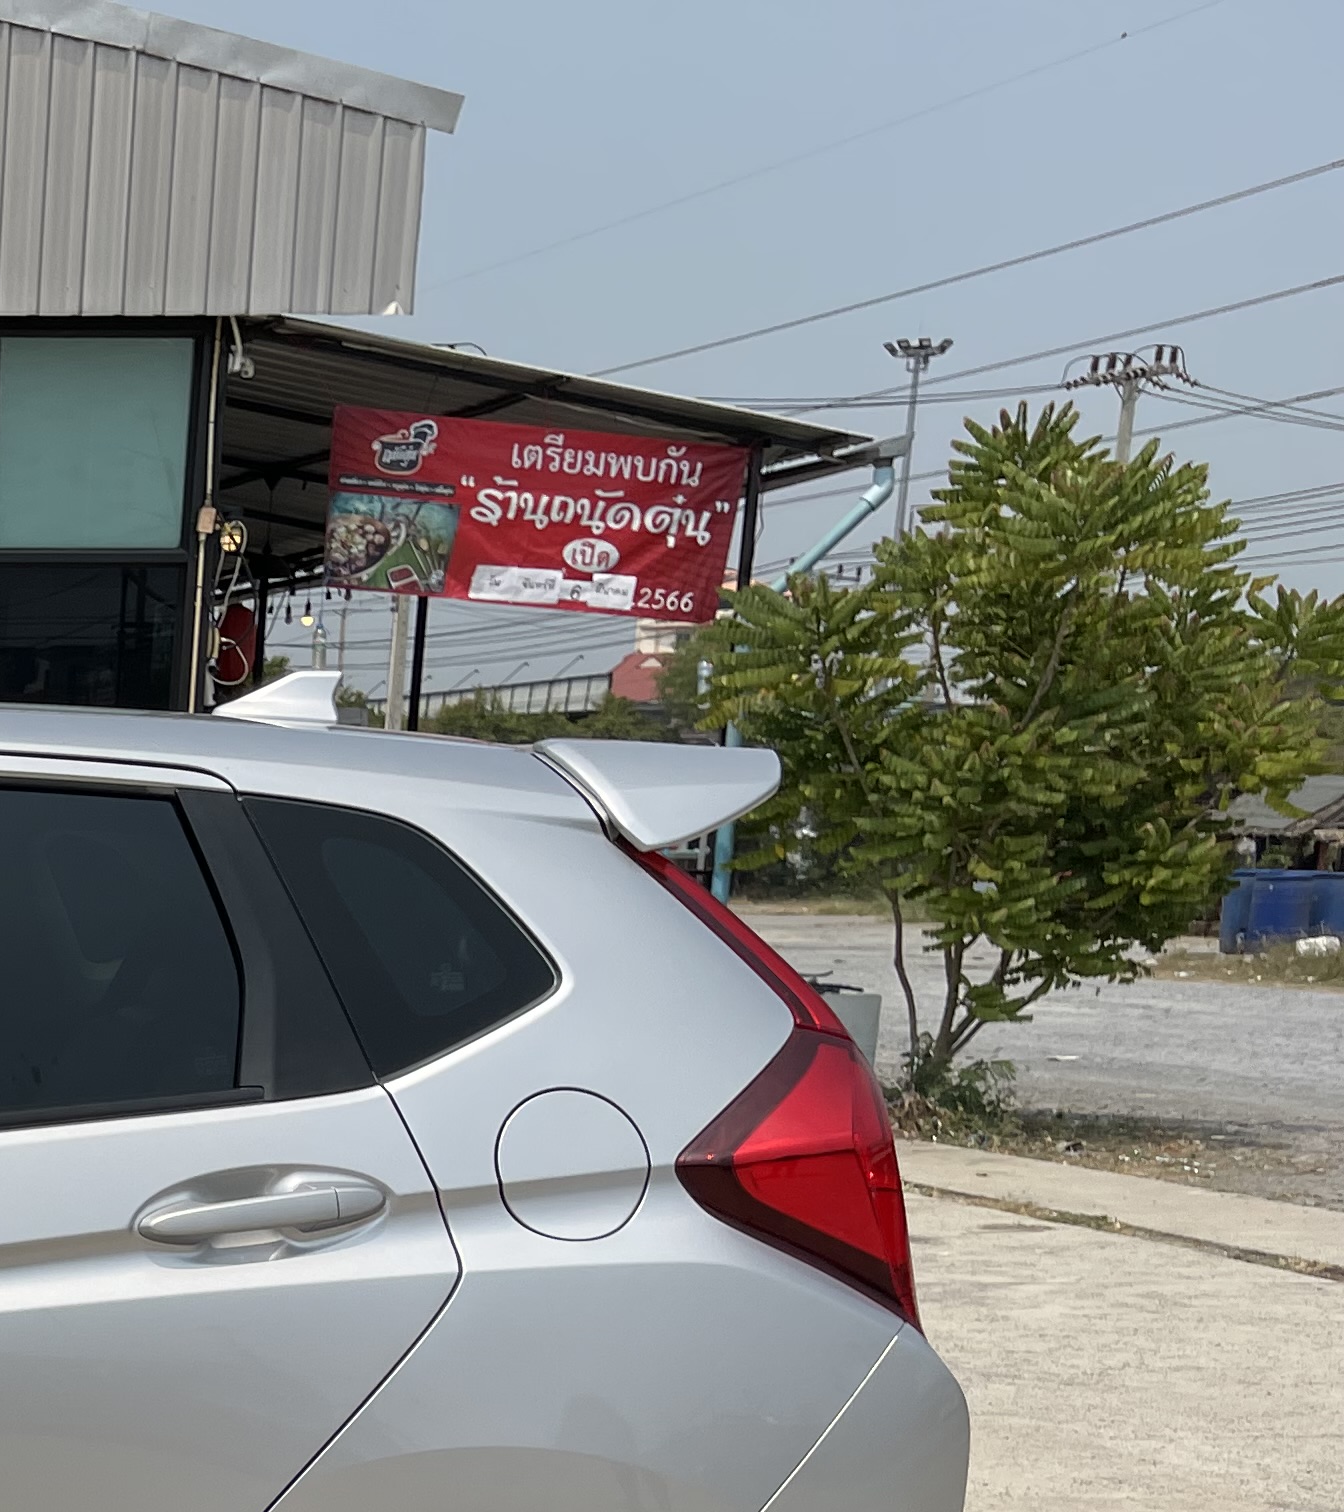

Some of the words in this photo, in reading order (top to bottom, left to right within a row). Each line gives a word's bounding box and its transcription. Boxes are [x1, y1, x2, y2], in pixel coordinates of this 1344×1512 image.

[511, 433, 703, 487] เตรียมพบกัน
[571, 541, 611, 568] เปิด
